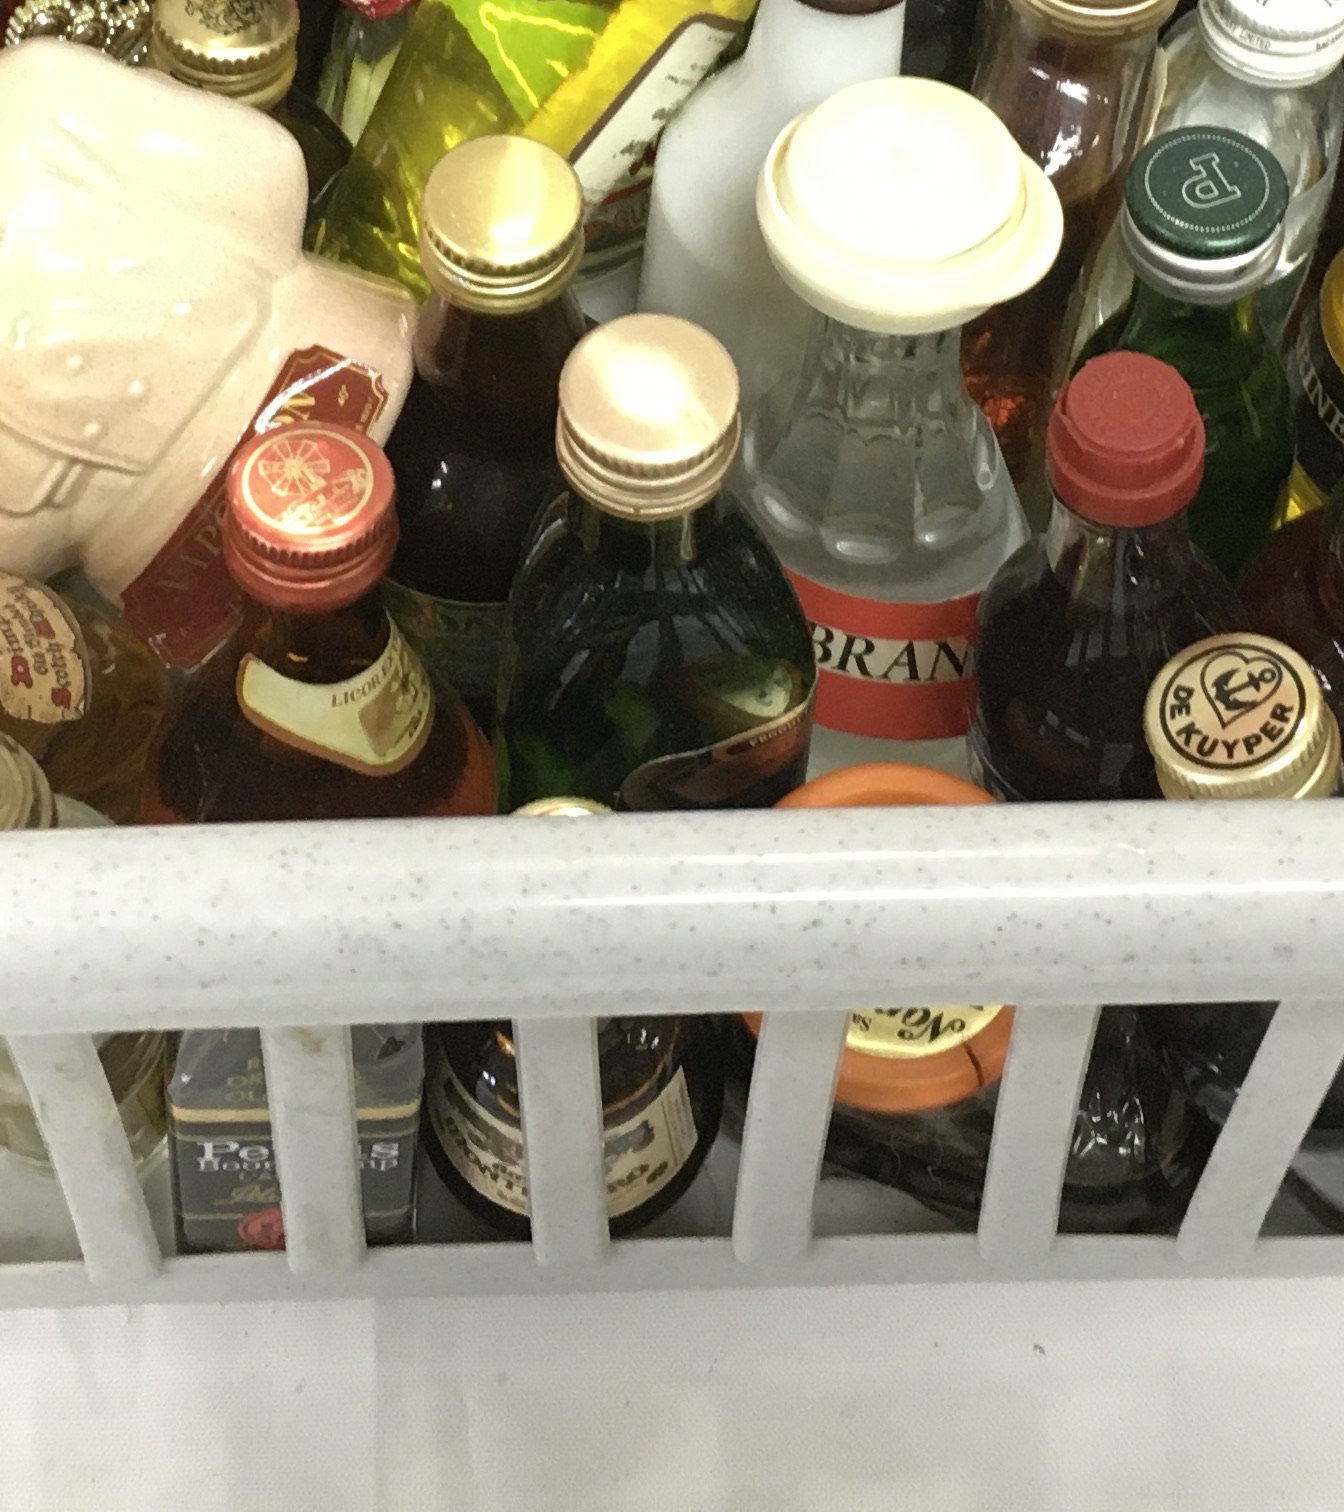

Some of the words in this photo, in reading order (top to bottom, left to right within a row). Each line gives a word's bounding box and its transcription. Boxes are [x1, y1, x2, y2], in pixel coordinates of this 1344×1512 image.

[1181, 151, 1242, 210] P
[808, 620, 970, 682] BRAN
[331, 673, 382, 709] LICOR
[1169, 683, 1196, 721] DE
[1175, 702, 1294, 759] KUYPER
